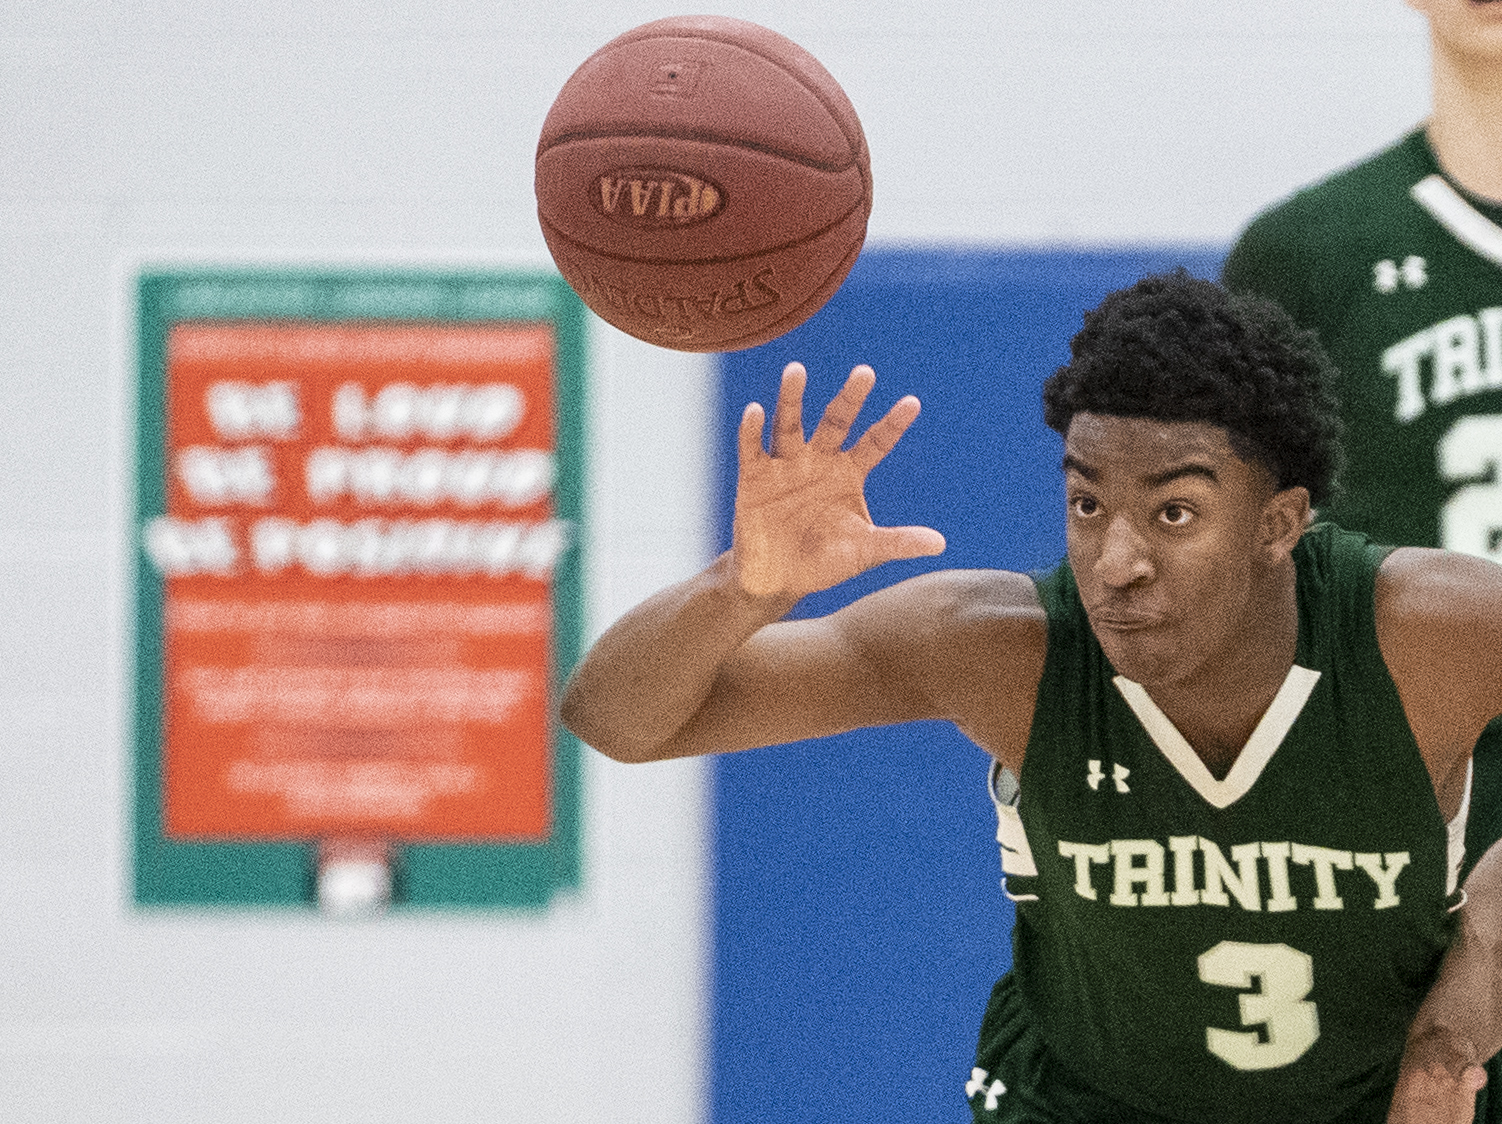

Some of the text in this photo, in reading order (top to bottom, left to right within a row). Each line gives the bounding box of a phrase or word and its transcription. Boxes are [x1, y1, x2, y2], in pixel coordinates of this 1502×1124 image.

[600, 176, 703, 218] PIAA
[1057, 834, 1411, 912] TRINITY
[1197, 940, 1321, 1071] 3
